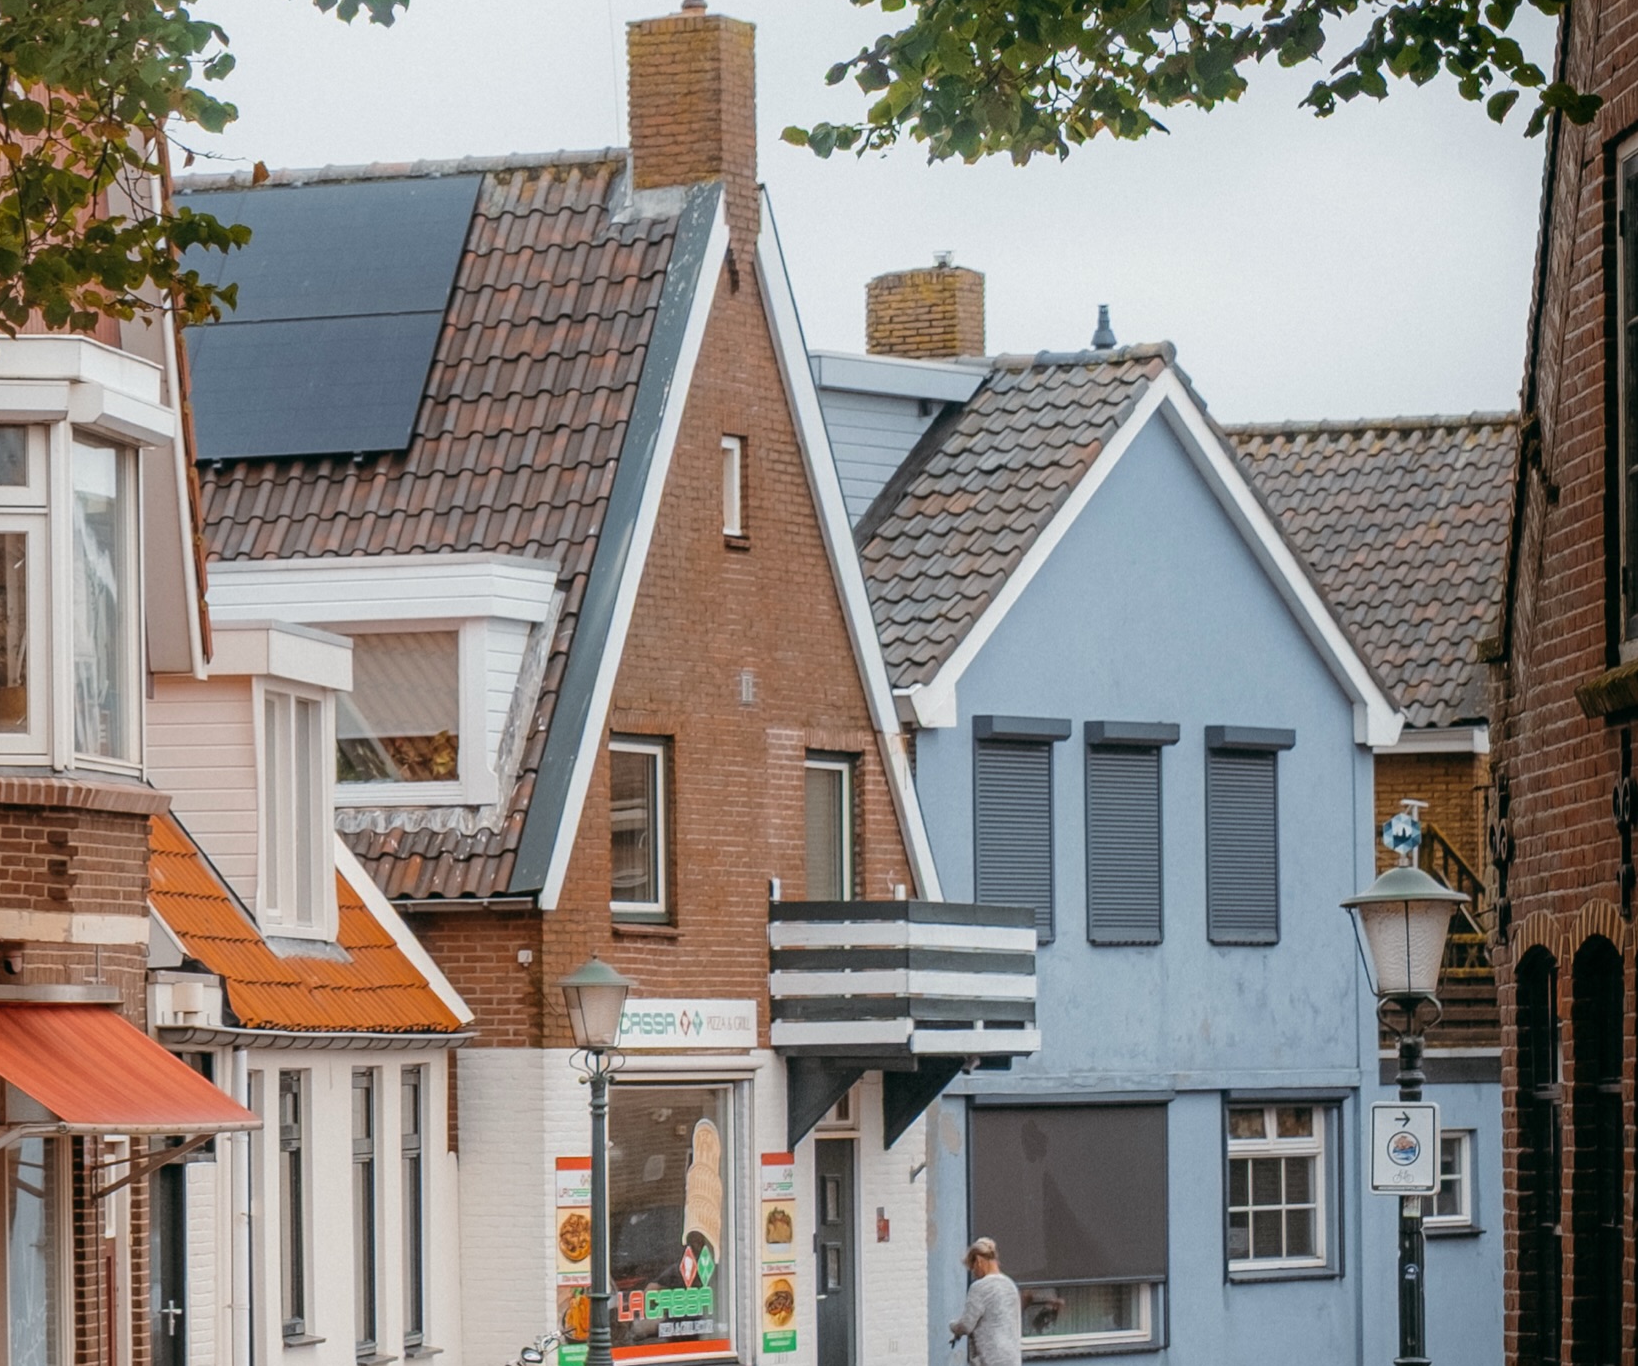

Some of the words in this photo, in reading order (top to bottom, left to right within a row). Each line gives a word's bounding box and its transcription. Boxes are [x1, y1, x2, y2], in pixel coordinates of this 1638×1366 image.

[619, 1012, 677, 1035] CASSA
[618, 1290, 644, 1322] LA
[645, 1286, 714, 1320] CASSA
